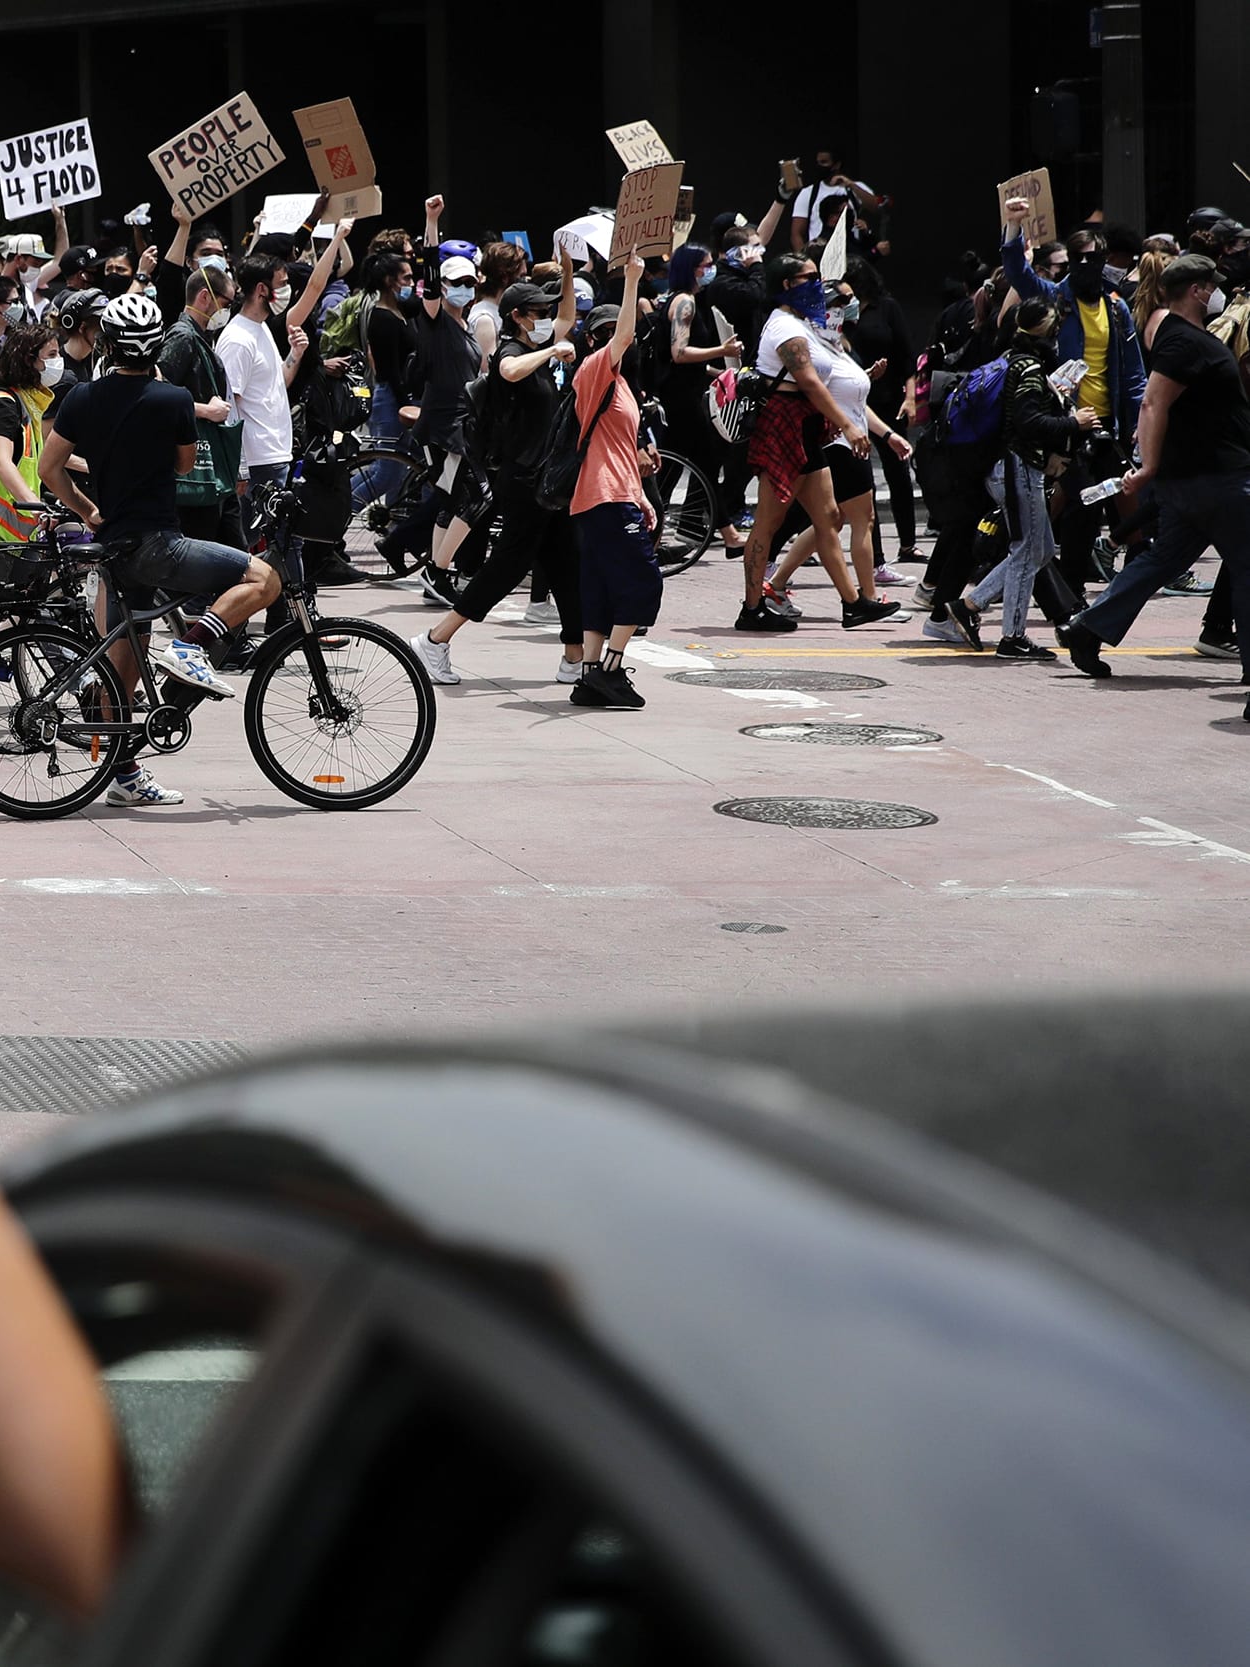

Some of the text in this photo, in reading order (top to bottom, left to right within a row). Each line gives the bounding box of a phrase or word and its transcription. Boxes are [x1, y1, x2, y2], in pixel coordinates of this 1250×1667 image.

[0, 124, 89, 174] JUSTICE
[158, 101, 253, 179] PEOPLE
[613, 123, 654, 144] BLACK
[622, 139, 666, 164] LIVES
[197, 138, 241, 174] OVER
[5, 162, 96, 206] 4 FLOYD
[178, 134, 278, 217] PROPERTY
[624, 168, 659, 199] STOP
[616, 215, 675, 249] RUTALITY
